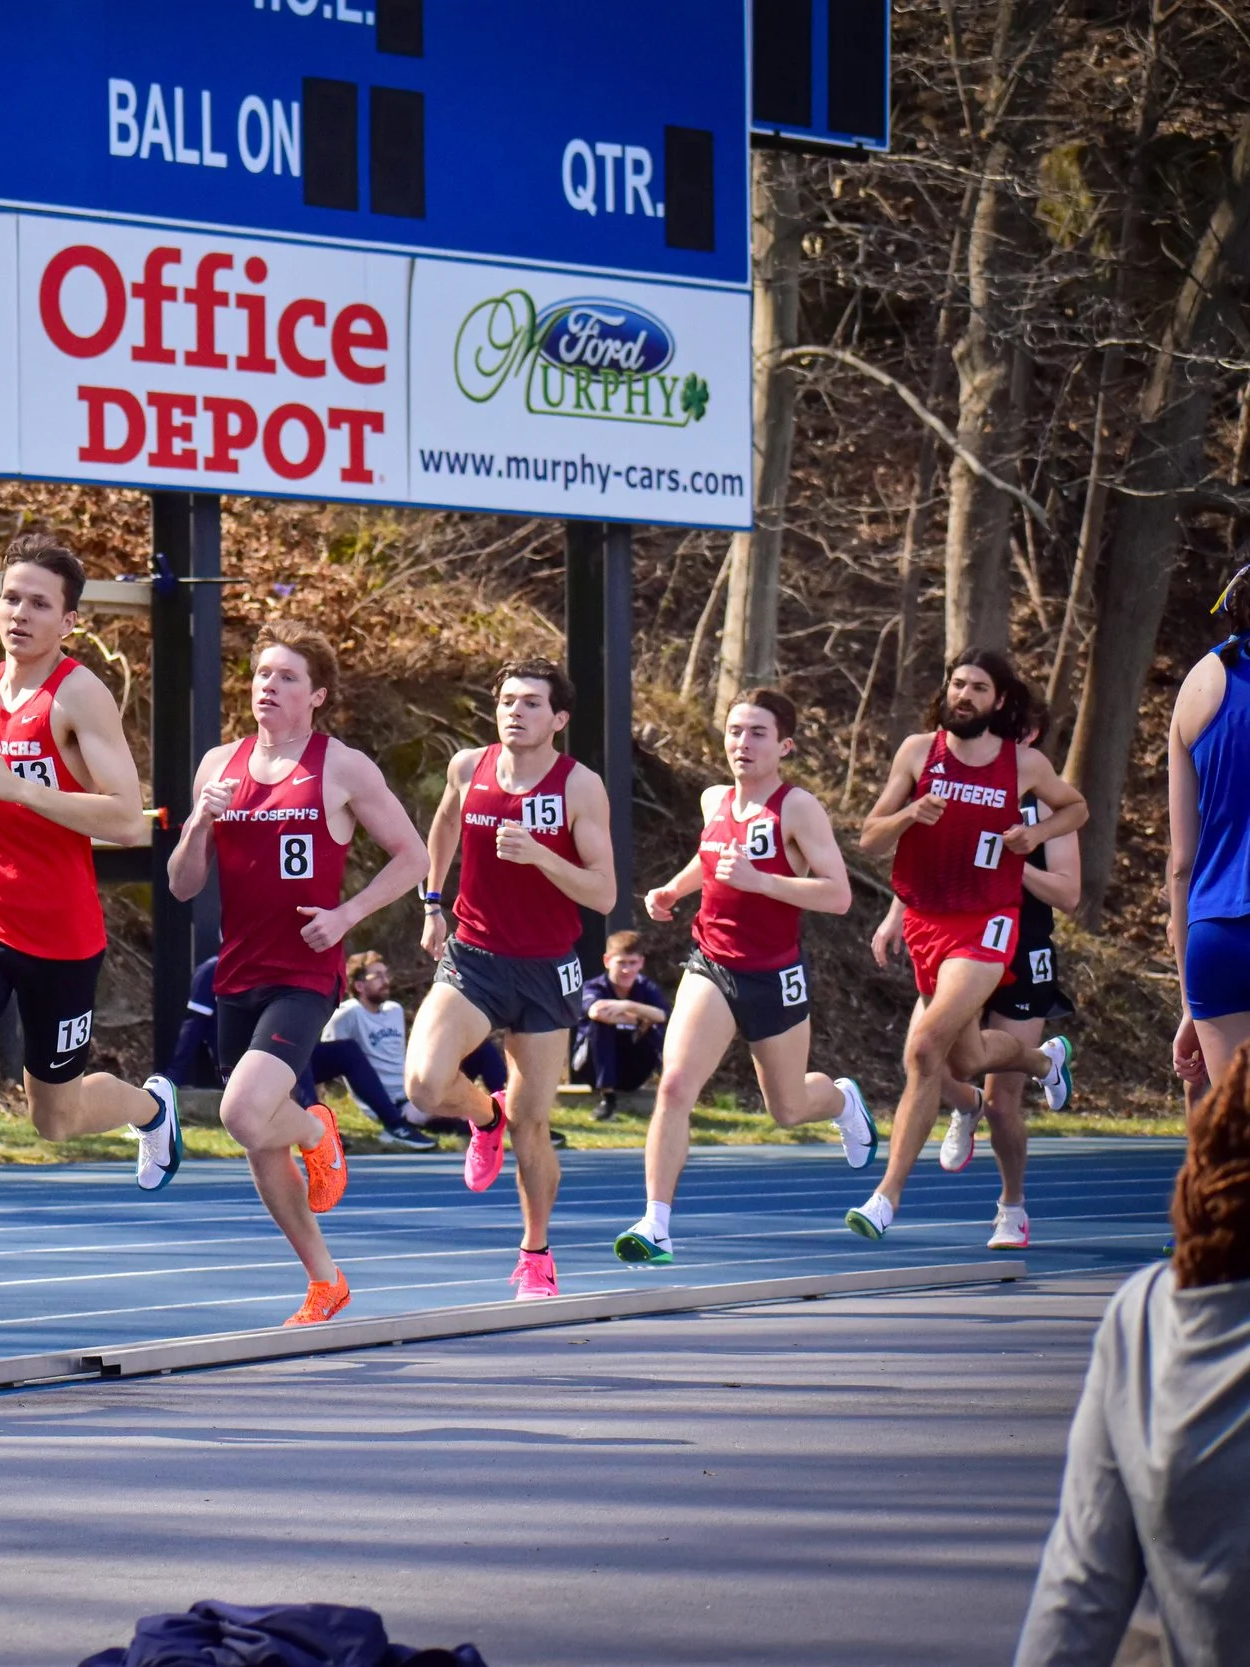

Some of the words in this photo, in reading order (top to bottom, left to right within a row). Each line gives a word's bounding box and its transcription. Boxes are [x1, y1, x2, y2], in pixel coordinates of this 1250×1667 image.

[108, 78, 228, 168] BALL
[236, 96, 301, 178] ON
[562, 139, 665, 217] QTR.
[39, 245, 388, 384] Office
[558, 308, 647, 370] Ford
[78, 386, 384, 484] DEPOT
[419, 445, 744, 497] www.murphy-cars.com
[14, 761, 51, 788] 13
[931, 779, 1007, 808] RUTGERS
[214, 809, 249, 822] AINT
[250, 808, 319, 822] JOSEPH'S
[465, 813, 497, 827] SAINT
[525, 797, 557, 826] 15
[750, 824, 769, 856] 5
[983, 836, 998, 865] 1
[284, 838, 308, 876] 8
[992, 918, 1005, 947] 1
[561, 963, 581, 994] 15
[1035, 952, 1049, 979] 4
[785, 970, 802, 1001] 5
[62, 1016, 88, 1050] 13
